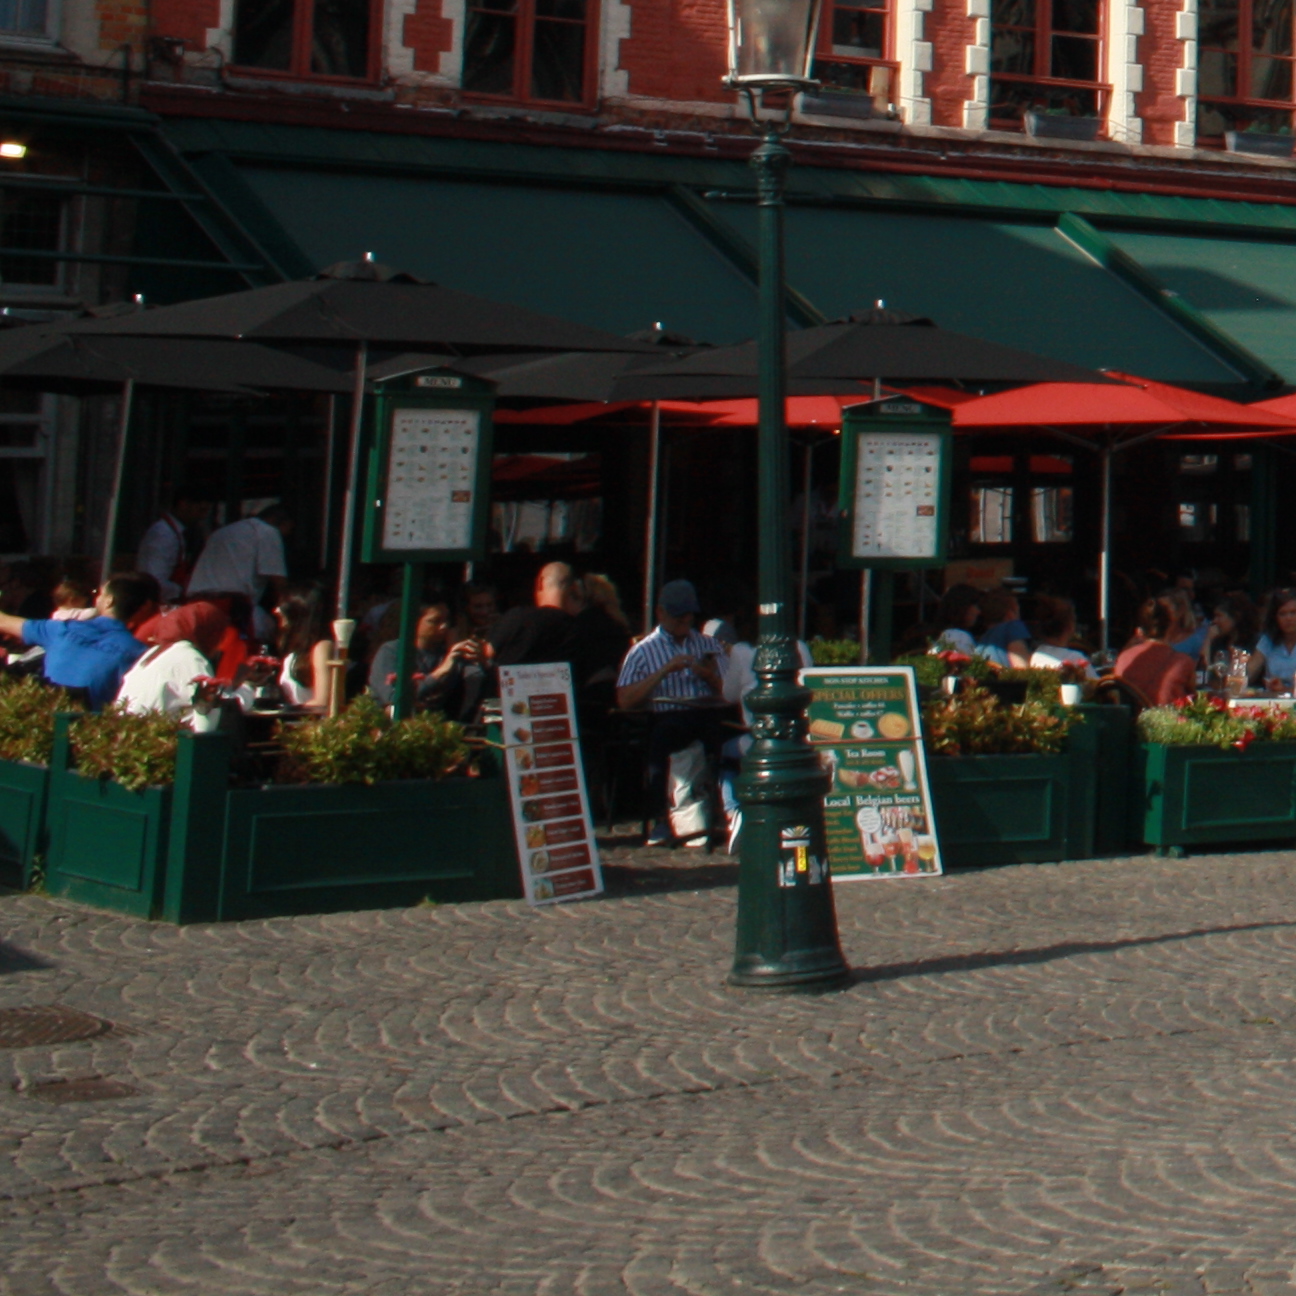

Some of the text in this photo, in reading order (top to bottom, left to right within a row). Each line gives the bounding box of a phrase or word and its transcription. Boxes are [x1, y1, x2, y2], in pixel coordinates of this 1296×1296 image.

[845, 749, 886, 758] Tea Room
[824, 793, 920, 807] Local Belgian beers
